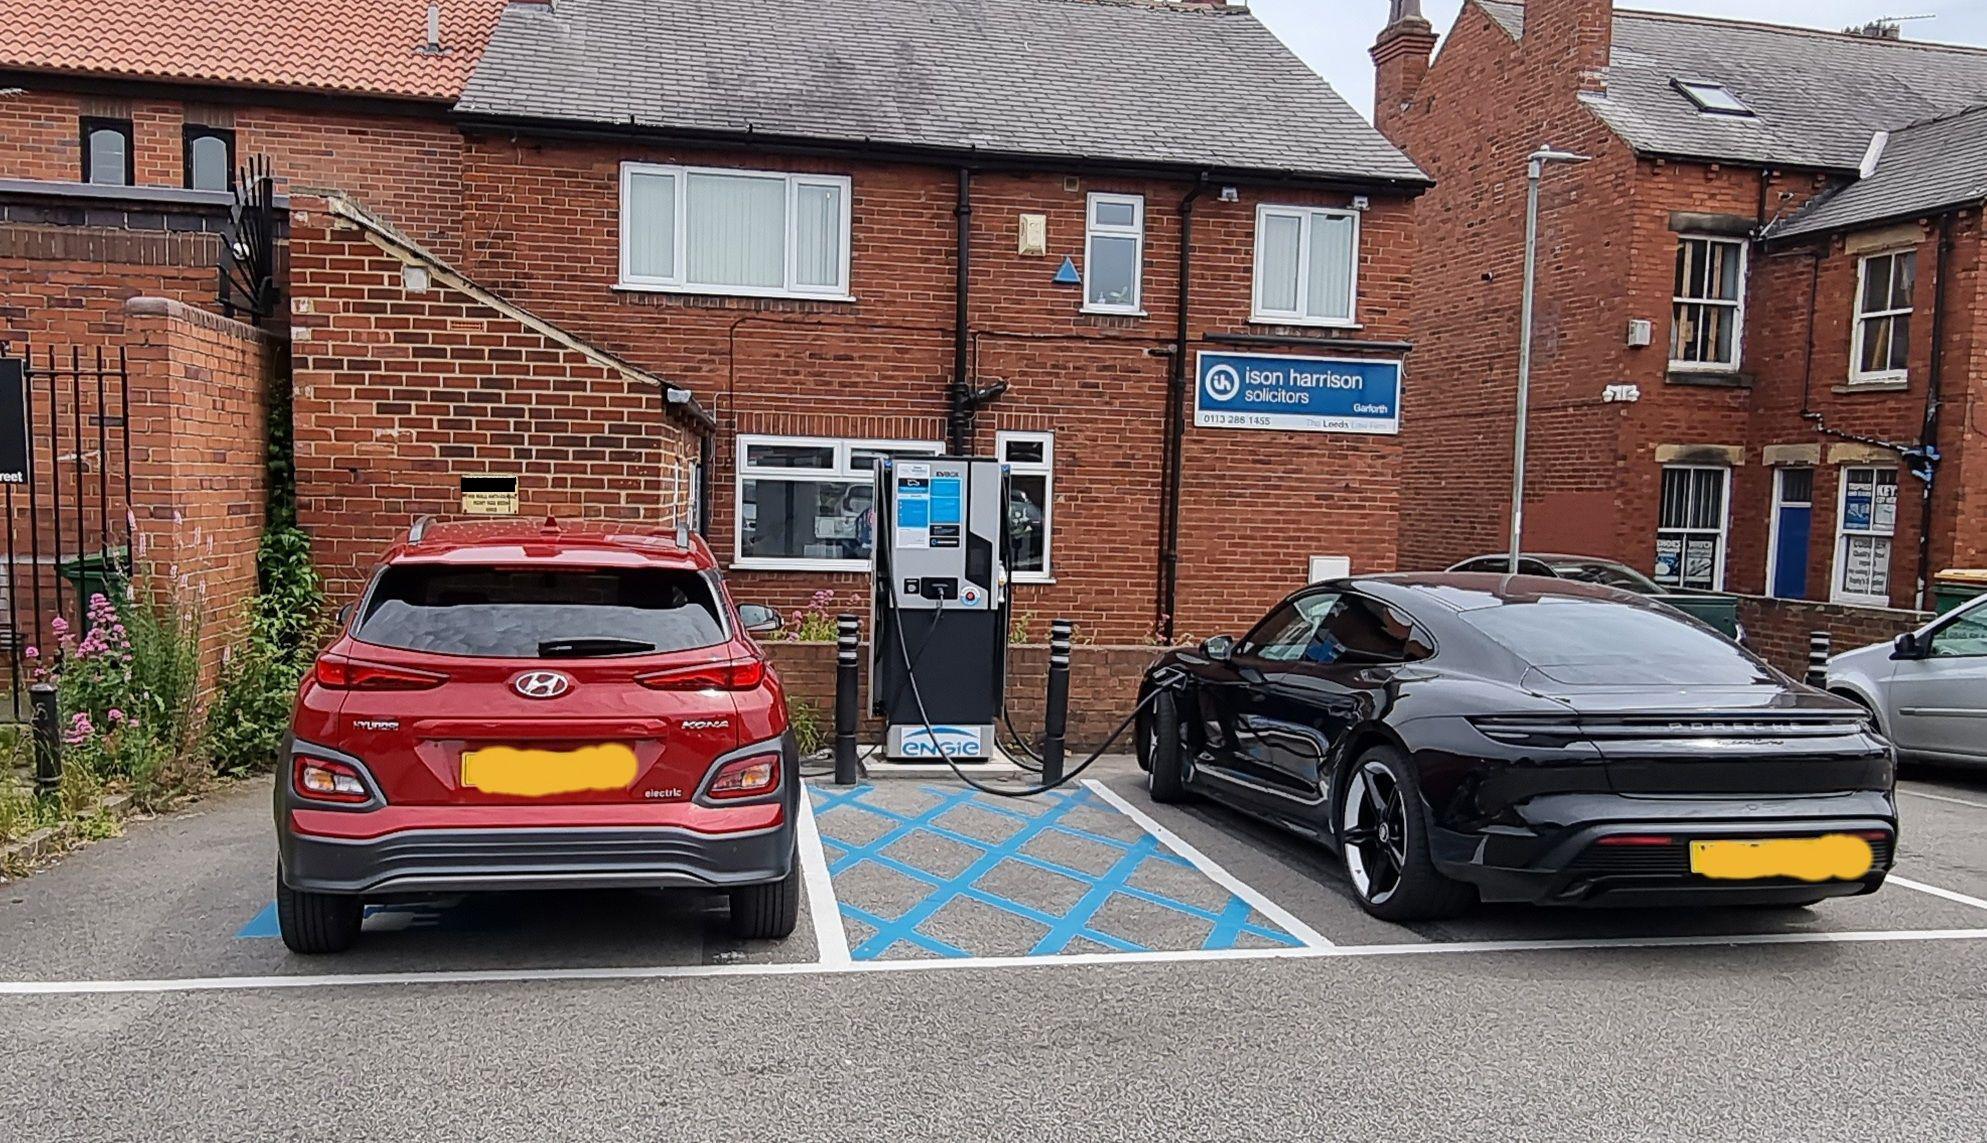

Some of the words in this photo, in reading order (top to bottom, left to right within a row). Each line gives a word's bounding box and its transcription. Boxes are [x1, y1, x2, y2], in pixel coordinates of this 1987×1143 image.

[1245, 366, 1283, 386] ison
[1290, 369, 1363, 390] harrison
[1244, 387, 1310, 404] solicitors
[1353, 403, 1388, 414] Garforth
[1203, 414, 1226, 424] 0113
[1248, 416, 1272, 426] 1455
[1322, 420, 1349, 429] Leeds
[644, 788, 682, 798] electric
